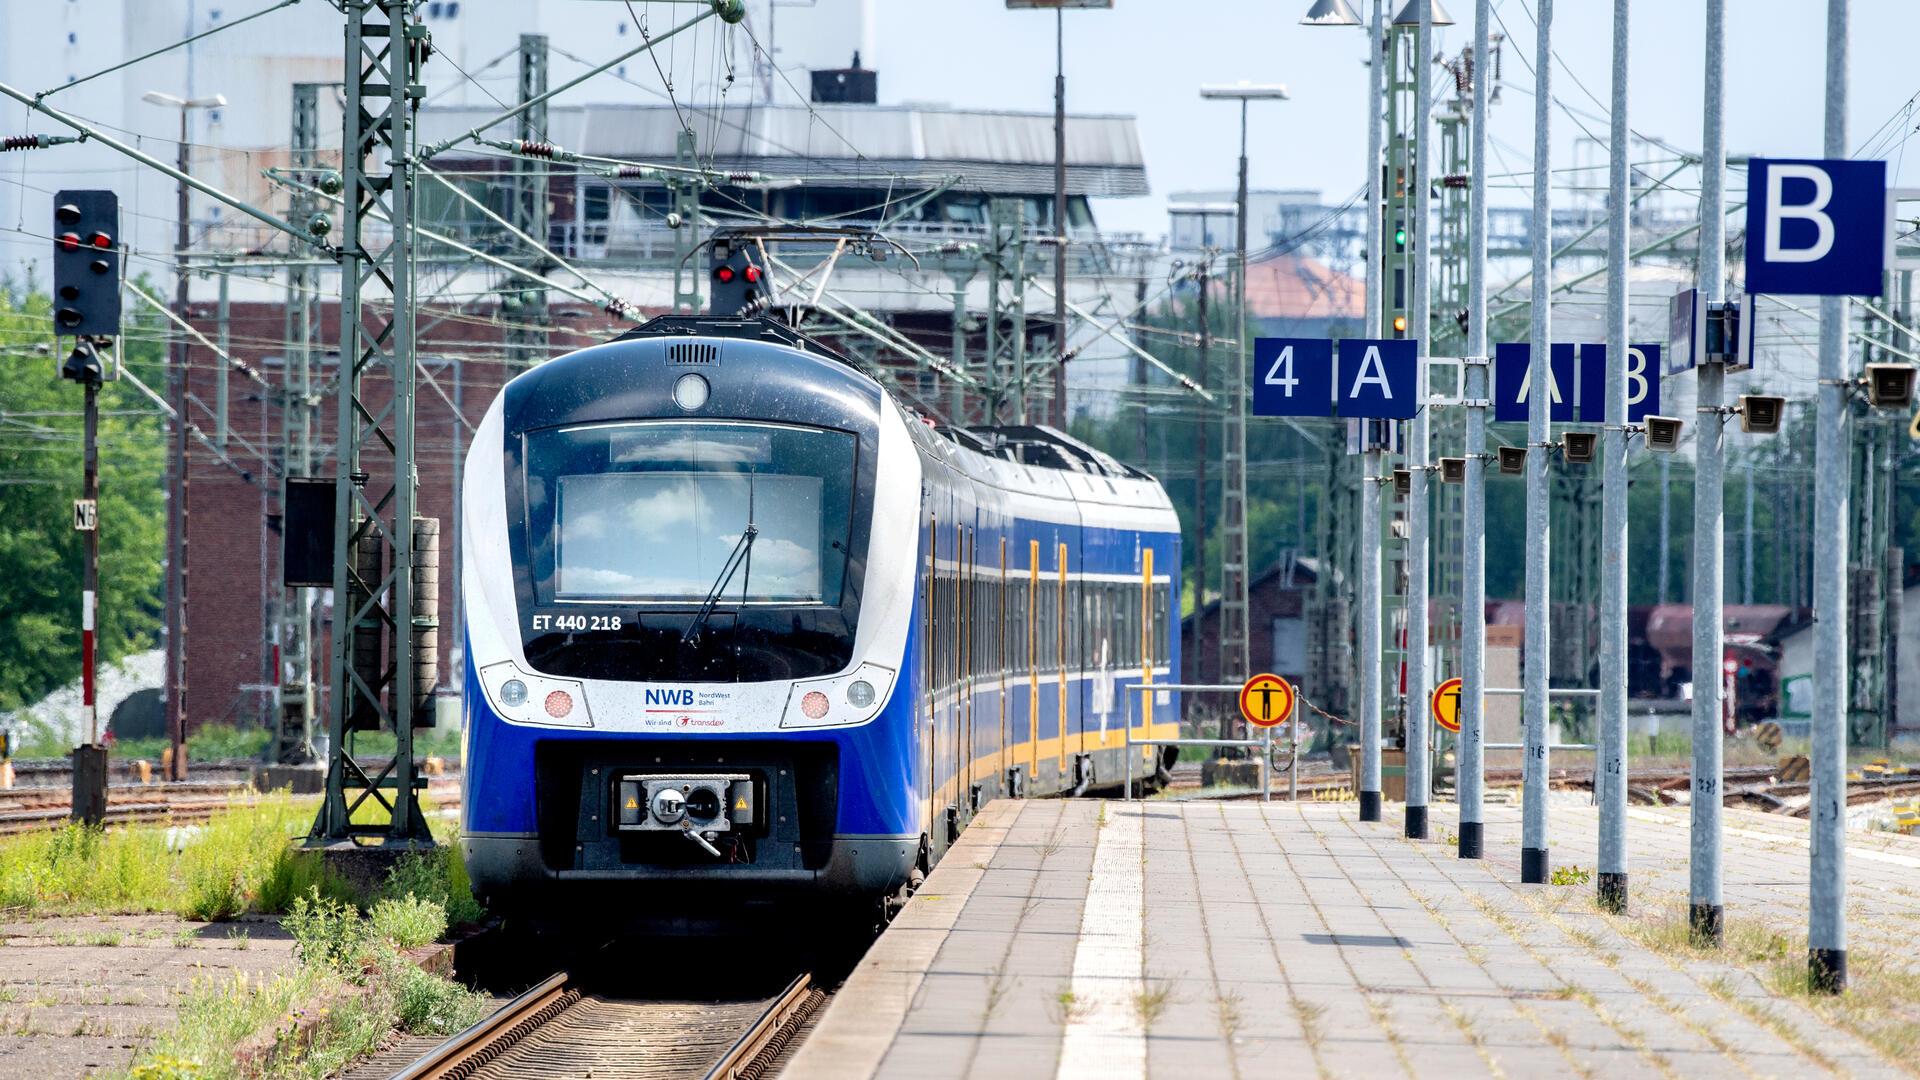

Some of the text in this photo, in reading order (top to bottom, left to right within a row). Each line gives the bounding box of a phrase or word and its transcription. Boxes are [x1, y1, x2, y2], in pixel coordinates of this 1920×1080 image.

[1764, 164, 1835, 263] B
[1264, 345, 1393, 399] 4 A
[532, 614, 622, 631] ET 440 218
[645, 688, 694, 706] NWB
